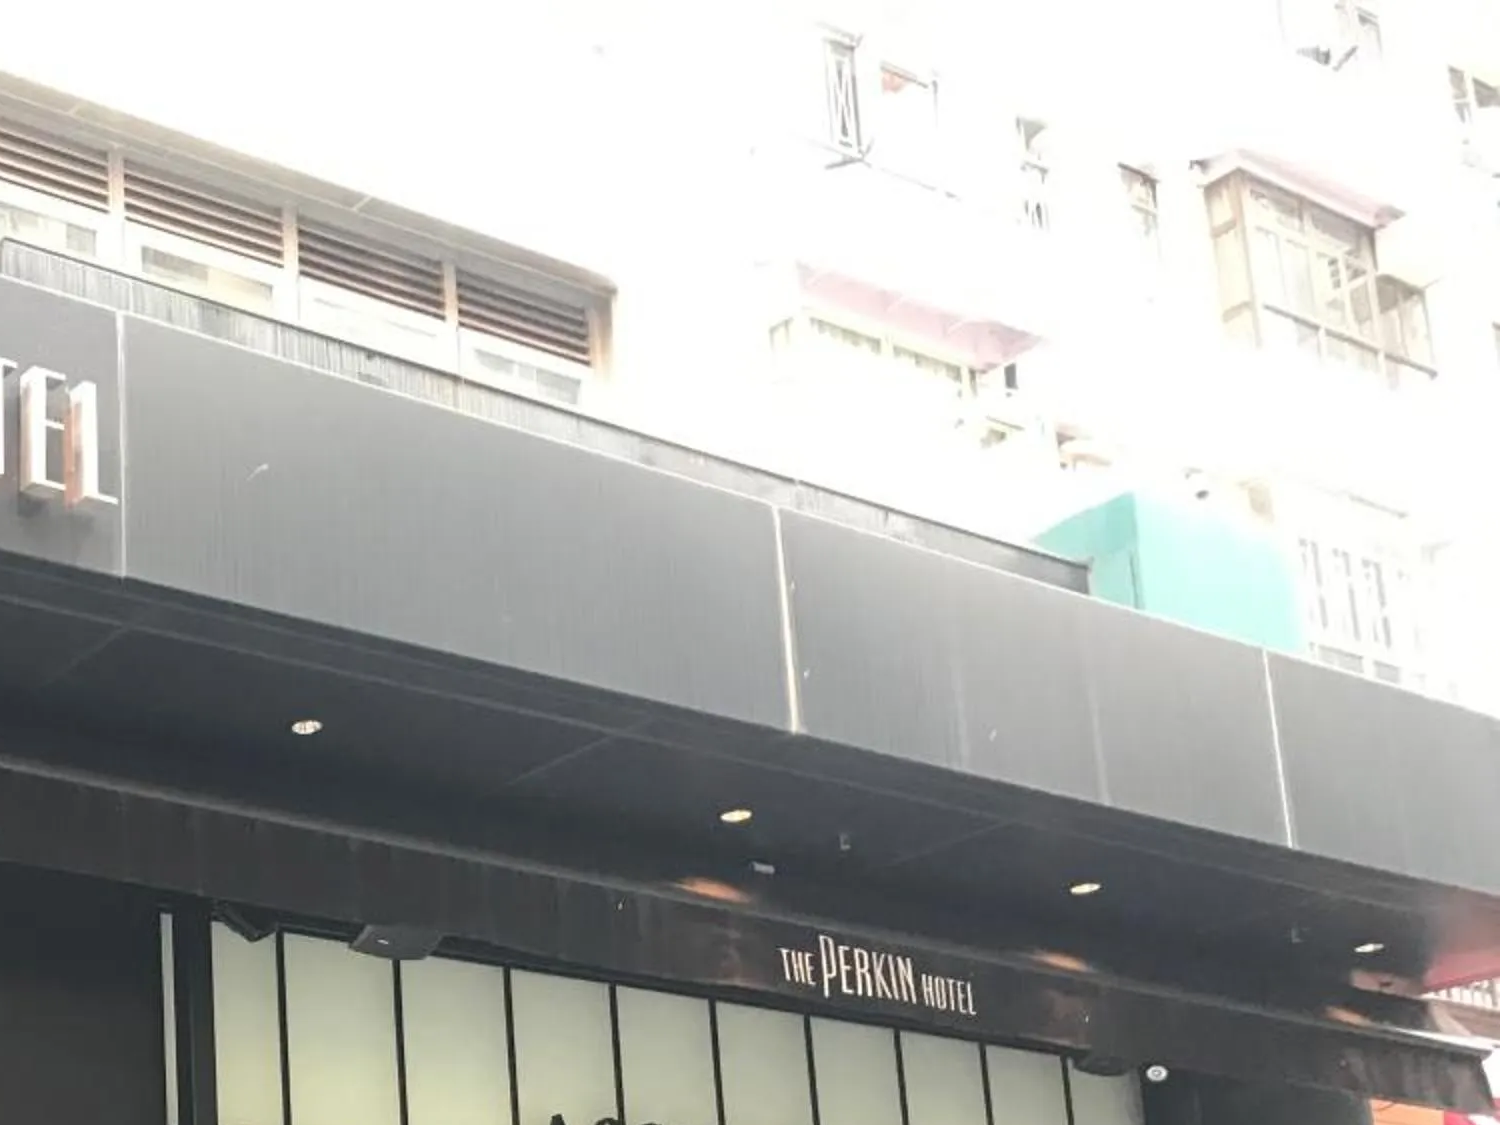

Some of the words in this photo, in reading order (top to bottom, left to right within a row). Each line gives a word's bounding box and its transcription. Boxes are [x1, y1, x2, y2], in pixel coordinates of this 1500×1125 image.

[780, 947, 817, 986] THE
[818, 934, 917, 1005] PERKIN
[921, 972, 977, 1016] HOTEL
